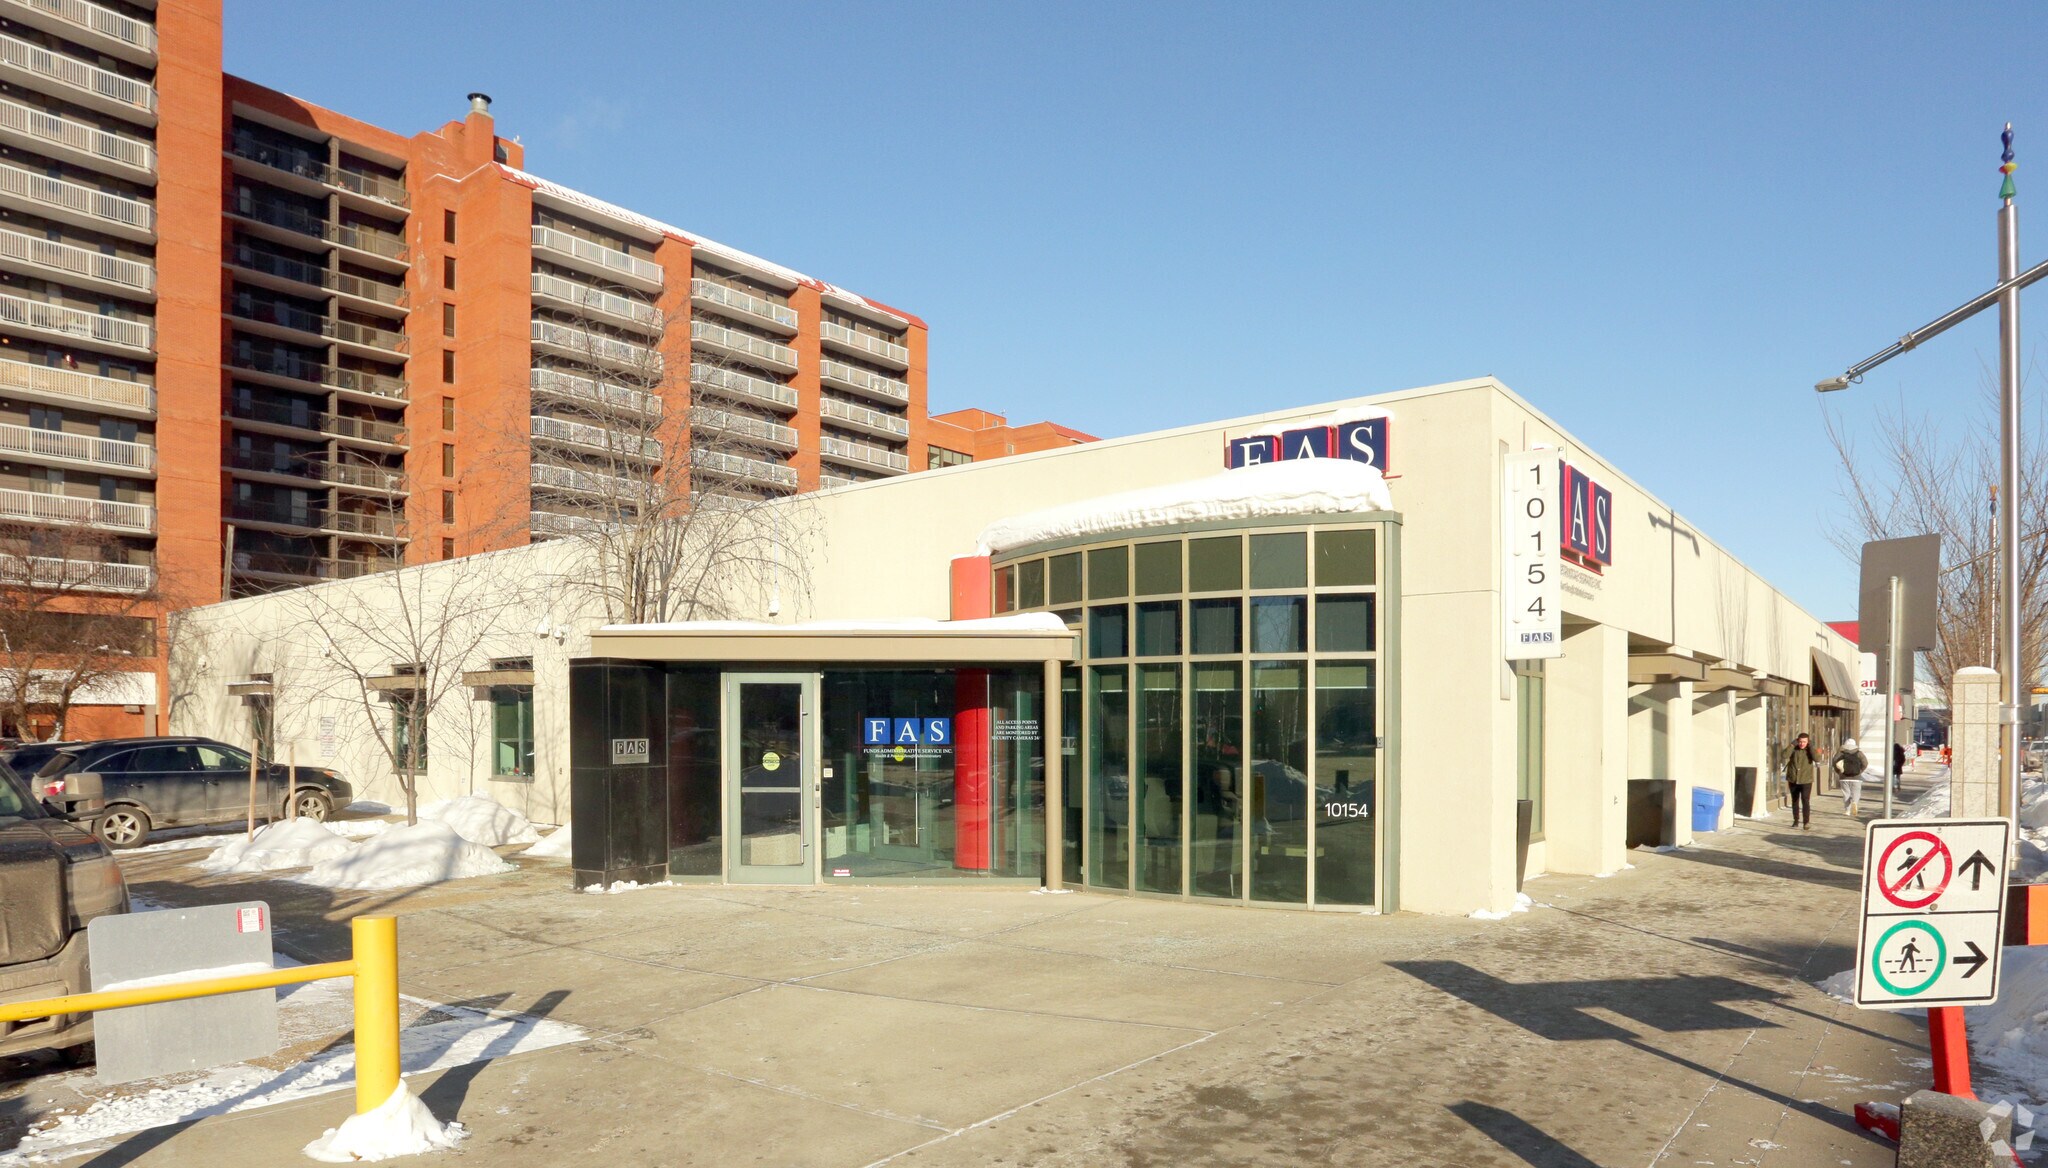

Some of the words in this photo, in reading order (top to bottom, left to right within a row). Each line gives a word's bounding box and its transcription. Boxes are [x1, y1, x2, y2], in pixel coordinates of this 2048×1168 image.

[1571, 481, 1607, 554] AS
[1526, 464, 1546, 617] 10154
[1522, 632, 1552, 643] FAS
[870, 720, 944, 742] FAS
[616, 741, 645, 754] FAS
[1324, 802, 1368, 818] 10154
